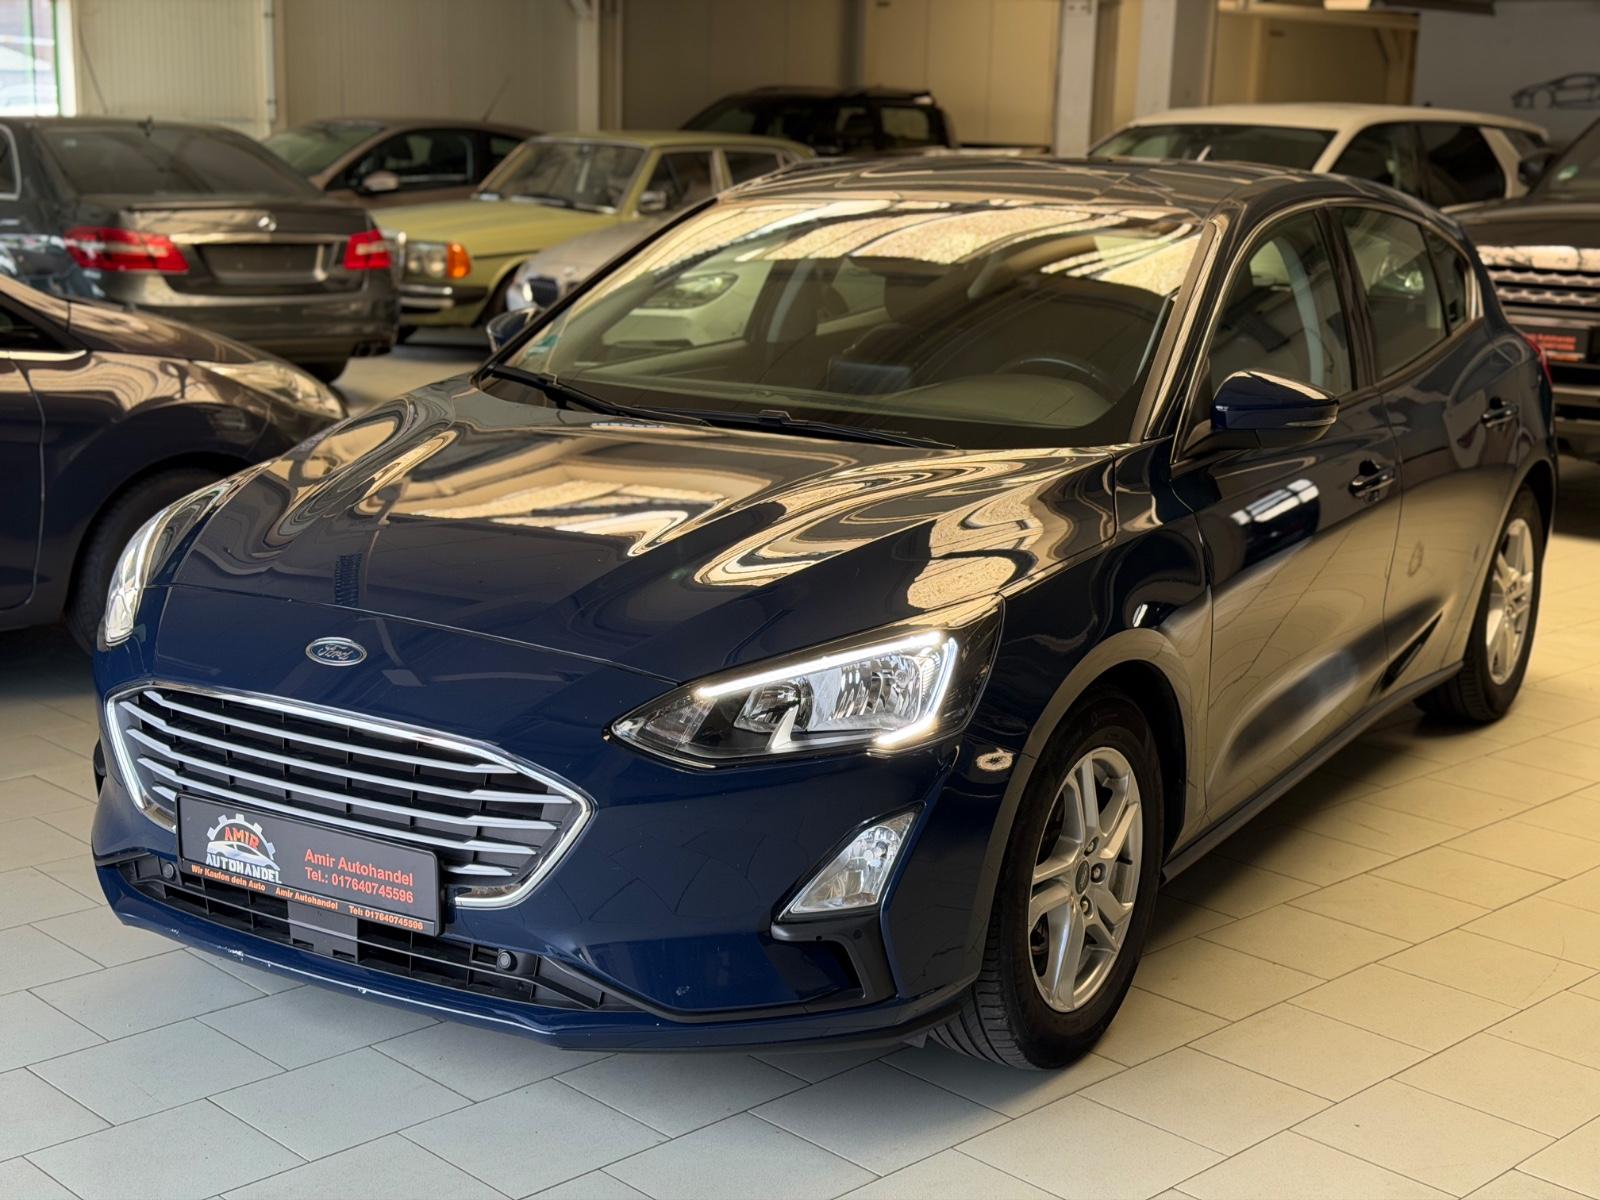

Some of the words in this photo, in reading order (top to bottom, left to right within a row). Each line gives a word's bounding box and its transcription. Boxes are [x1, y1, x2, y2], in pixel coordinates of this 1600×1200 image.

[317, 643, 354, 661] Ford
[224, 826, 260, 850] AMIR
[205, 853, 283, 884] AUTOHANDEL
[304, 848, 336, 868] Amir
[337, 856, 413, 887] Autohandel
[191, 864, 203, 875] Wir
[204, 868, 230, 882] Kaufen
[231, 875, 247, 887] dein
[248, 879, 266, 892] Auto
[275, 887, 294, 899] Amir
[294, 891, 338, 911] Autohandel
[364, 909, 424, 931] 017640745596
[304, 866, 329, 884] Tel.:
[331, 873, 414, 904] 017640745596
